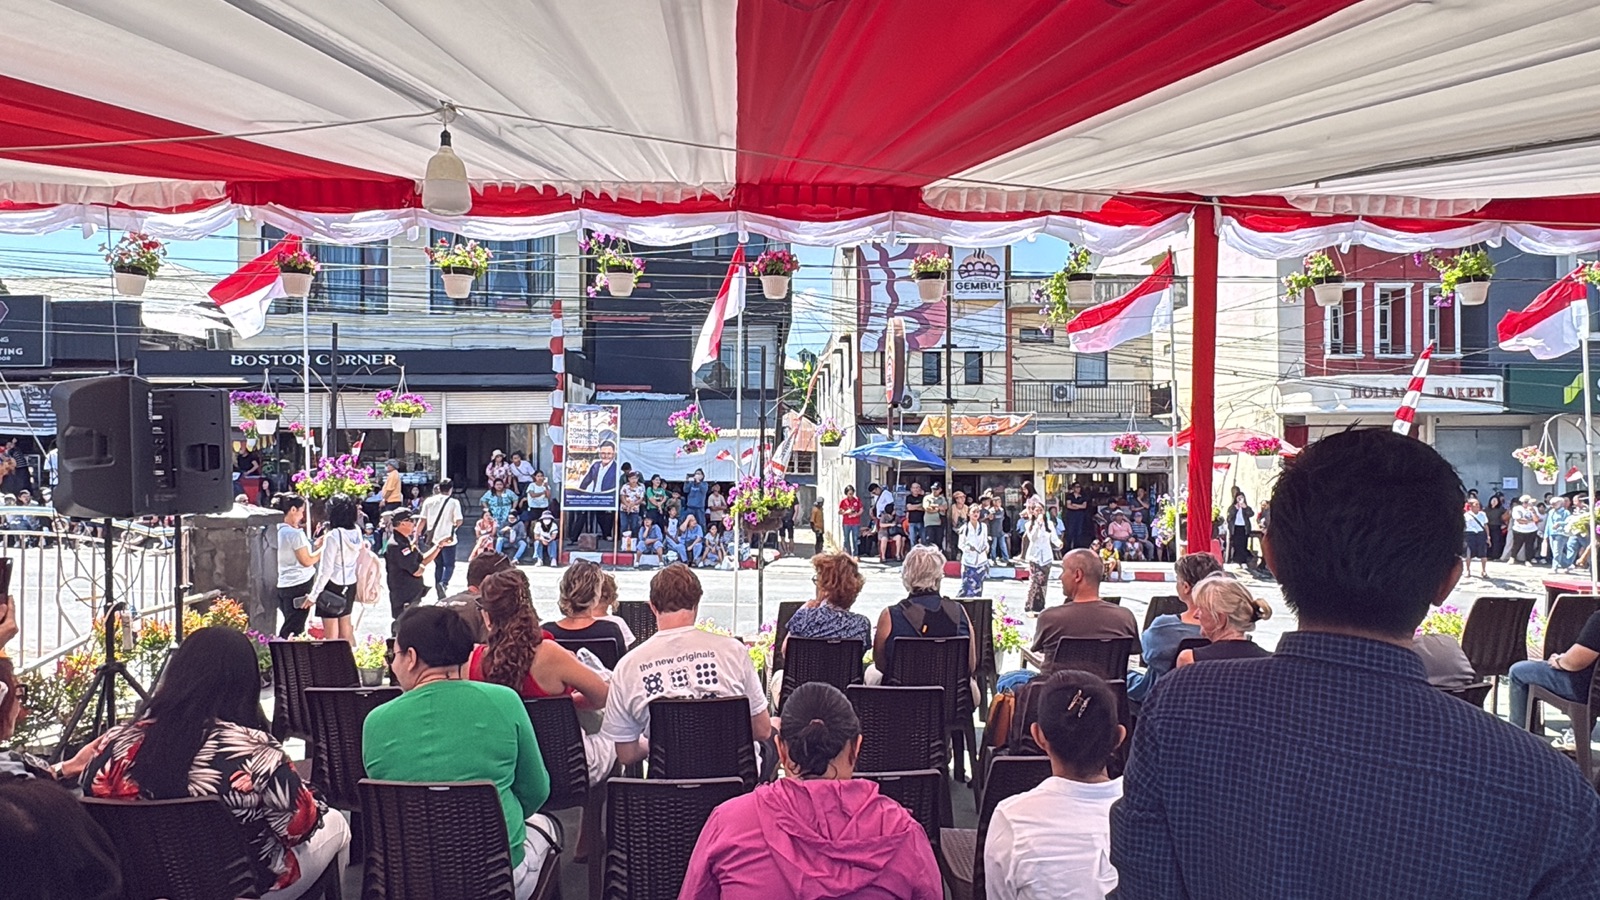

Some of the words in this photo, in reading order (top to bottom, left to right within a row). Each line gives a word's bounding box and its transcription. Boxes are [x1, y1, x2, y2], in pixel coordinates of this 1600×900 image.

[955, 281, 1003, 291] GEMBUL
[230, 353, 310, 366] BOSTON
[315, 353, 397, 366] CORNER
[1350, 387, 1409, 399] HOLLAN
[1434, 386, 1495, 399] BAKERY
[639, 662, 654, 672] the
[655, 657, 675, 667] new
[676, 650, 716, 662] originals
